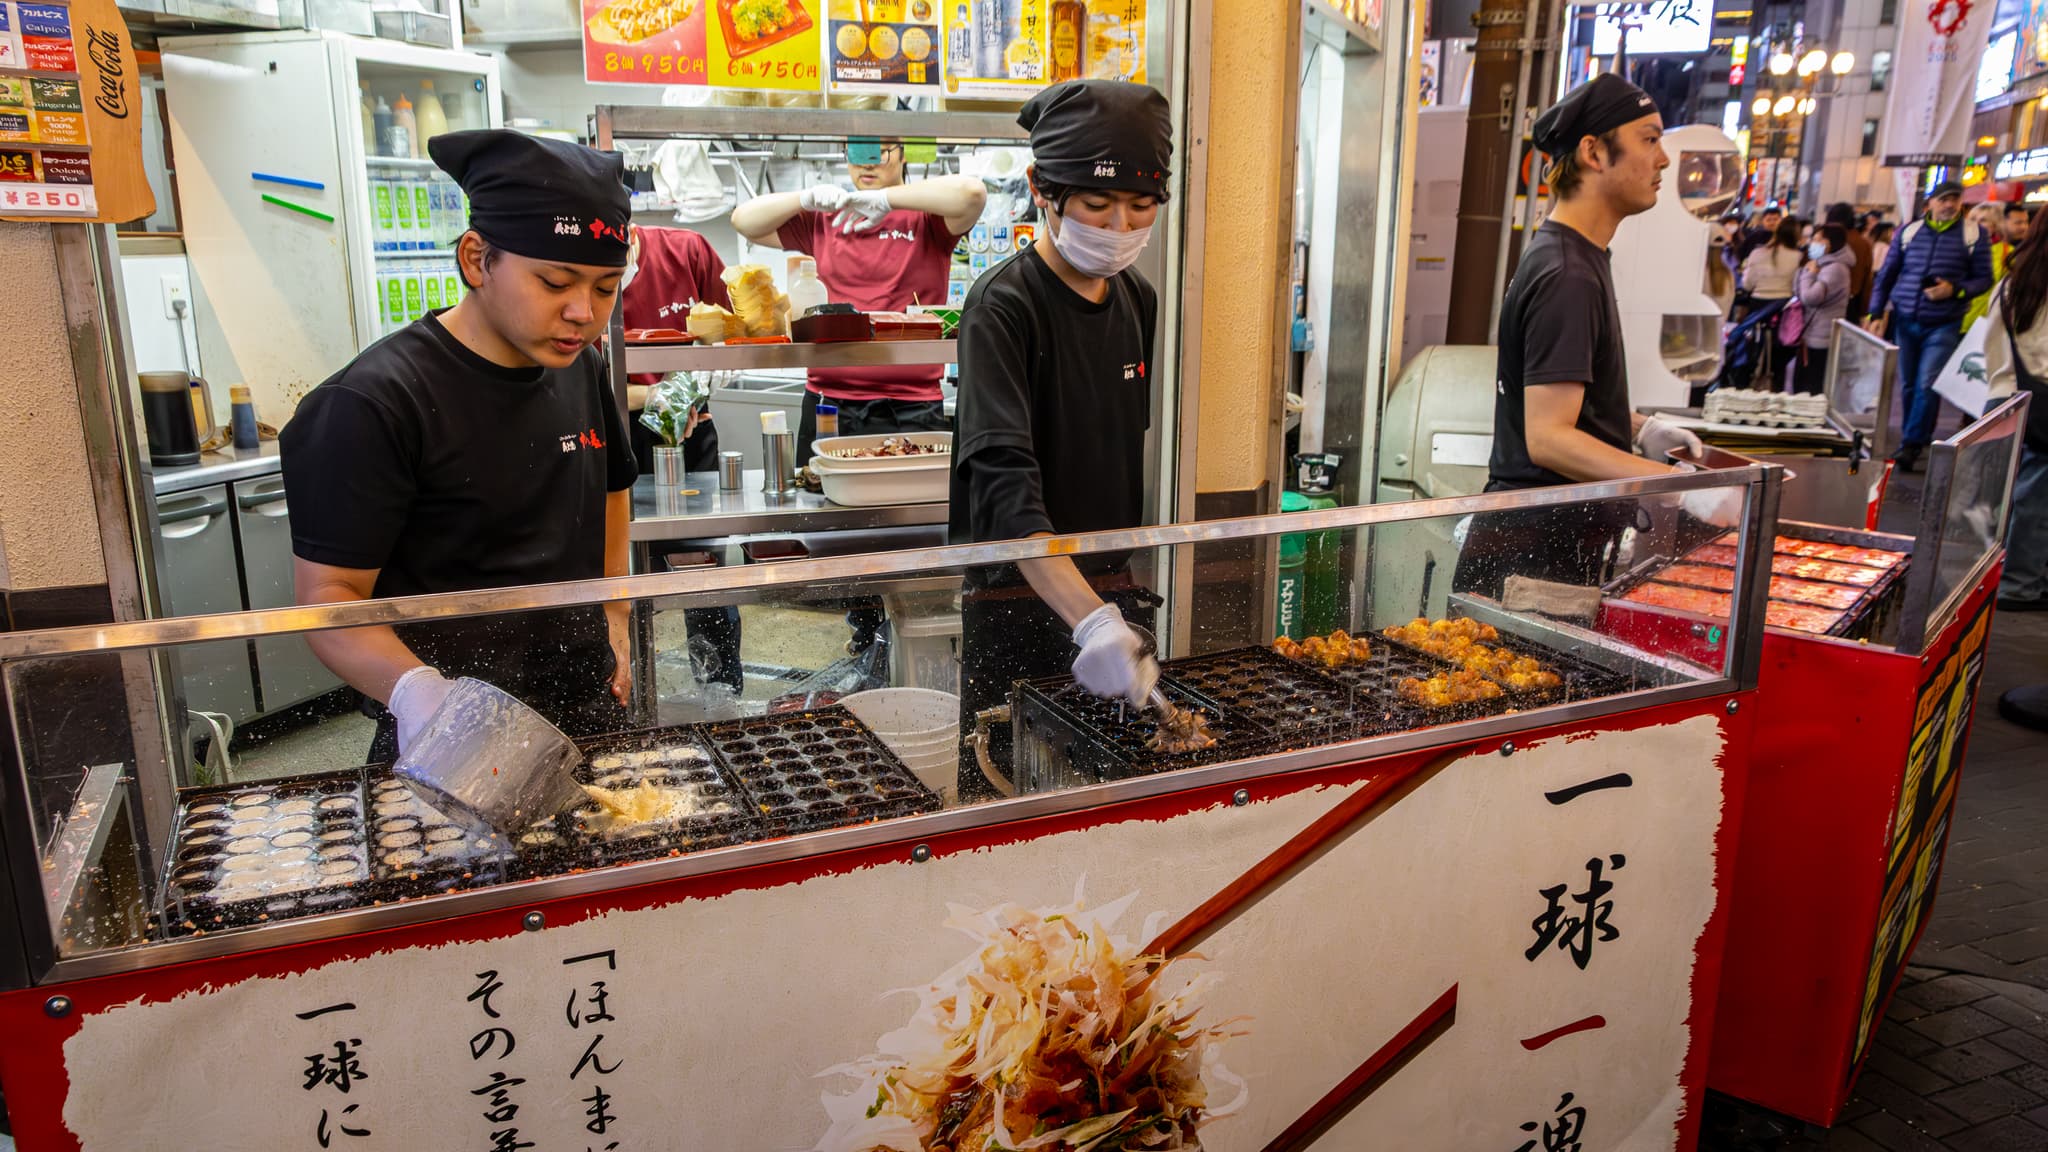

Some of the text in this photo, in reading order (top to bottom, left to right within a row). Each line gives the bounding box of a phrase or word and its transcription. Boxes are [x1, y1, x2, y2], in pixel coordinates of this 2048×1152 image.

[22, 8, 64, 20] カルピス
[25, 23, 67, 34] Calpico
[30, 53, 69, 62] Calpico
[39, 61, 63, 69] Soda
[49, 122, 73, 130] 100%
[43, 128, 79, 136] Orange
[49, 167, 85, 176] Oolong
[562, 949, 624, 1152] 「ほんま
[295, 1002, 370, 1149] 一球に
